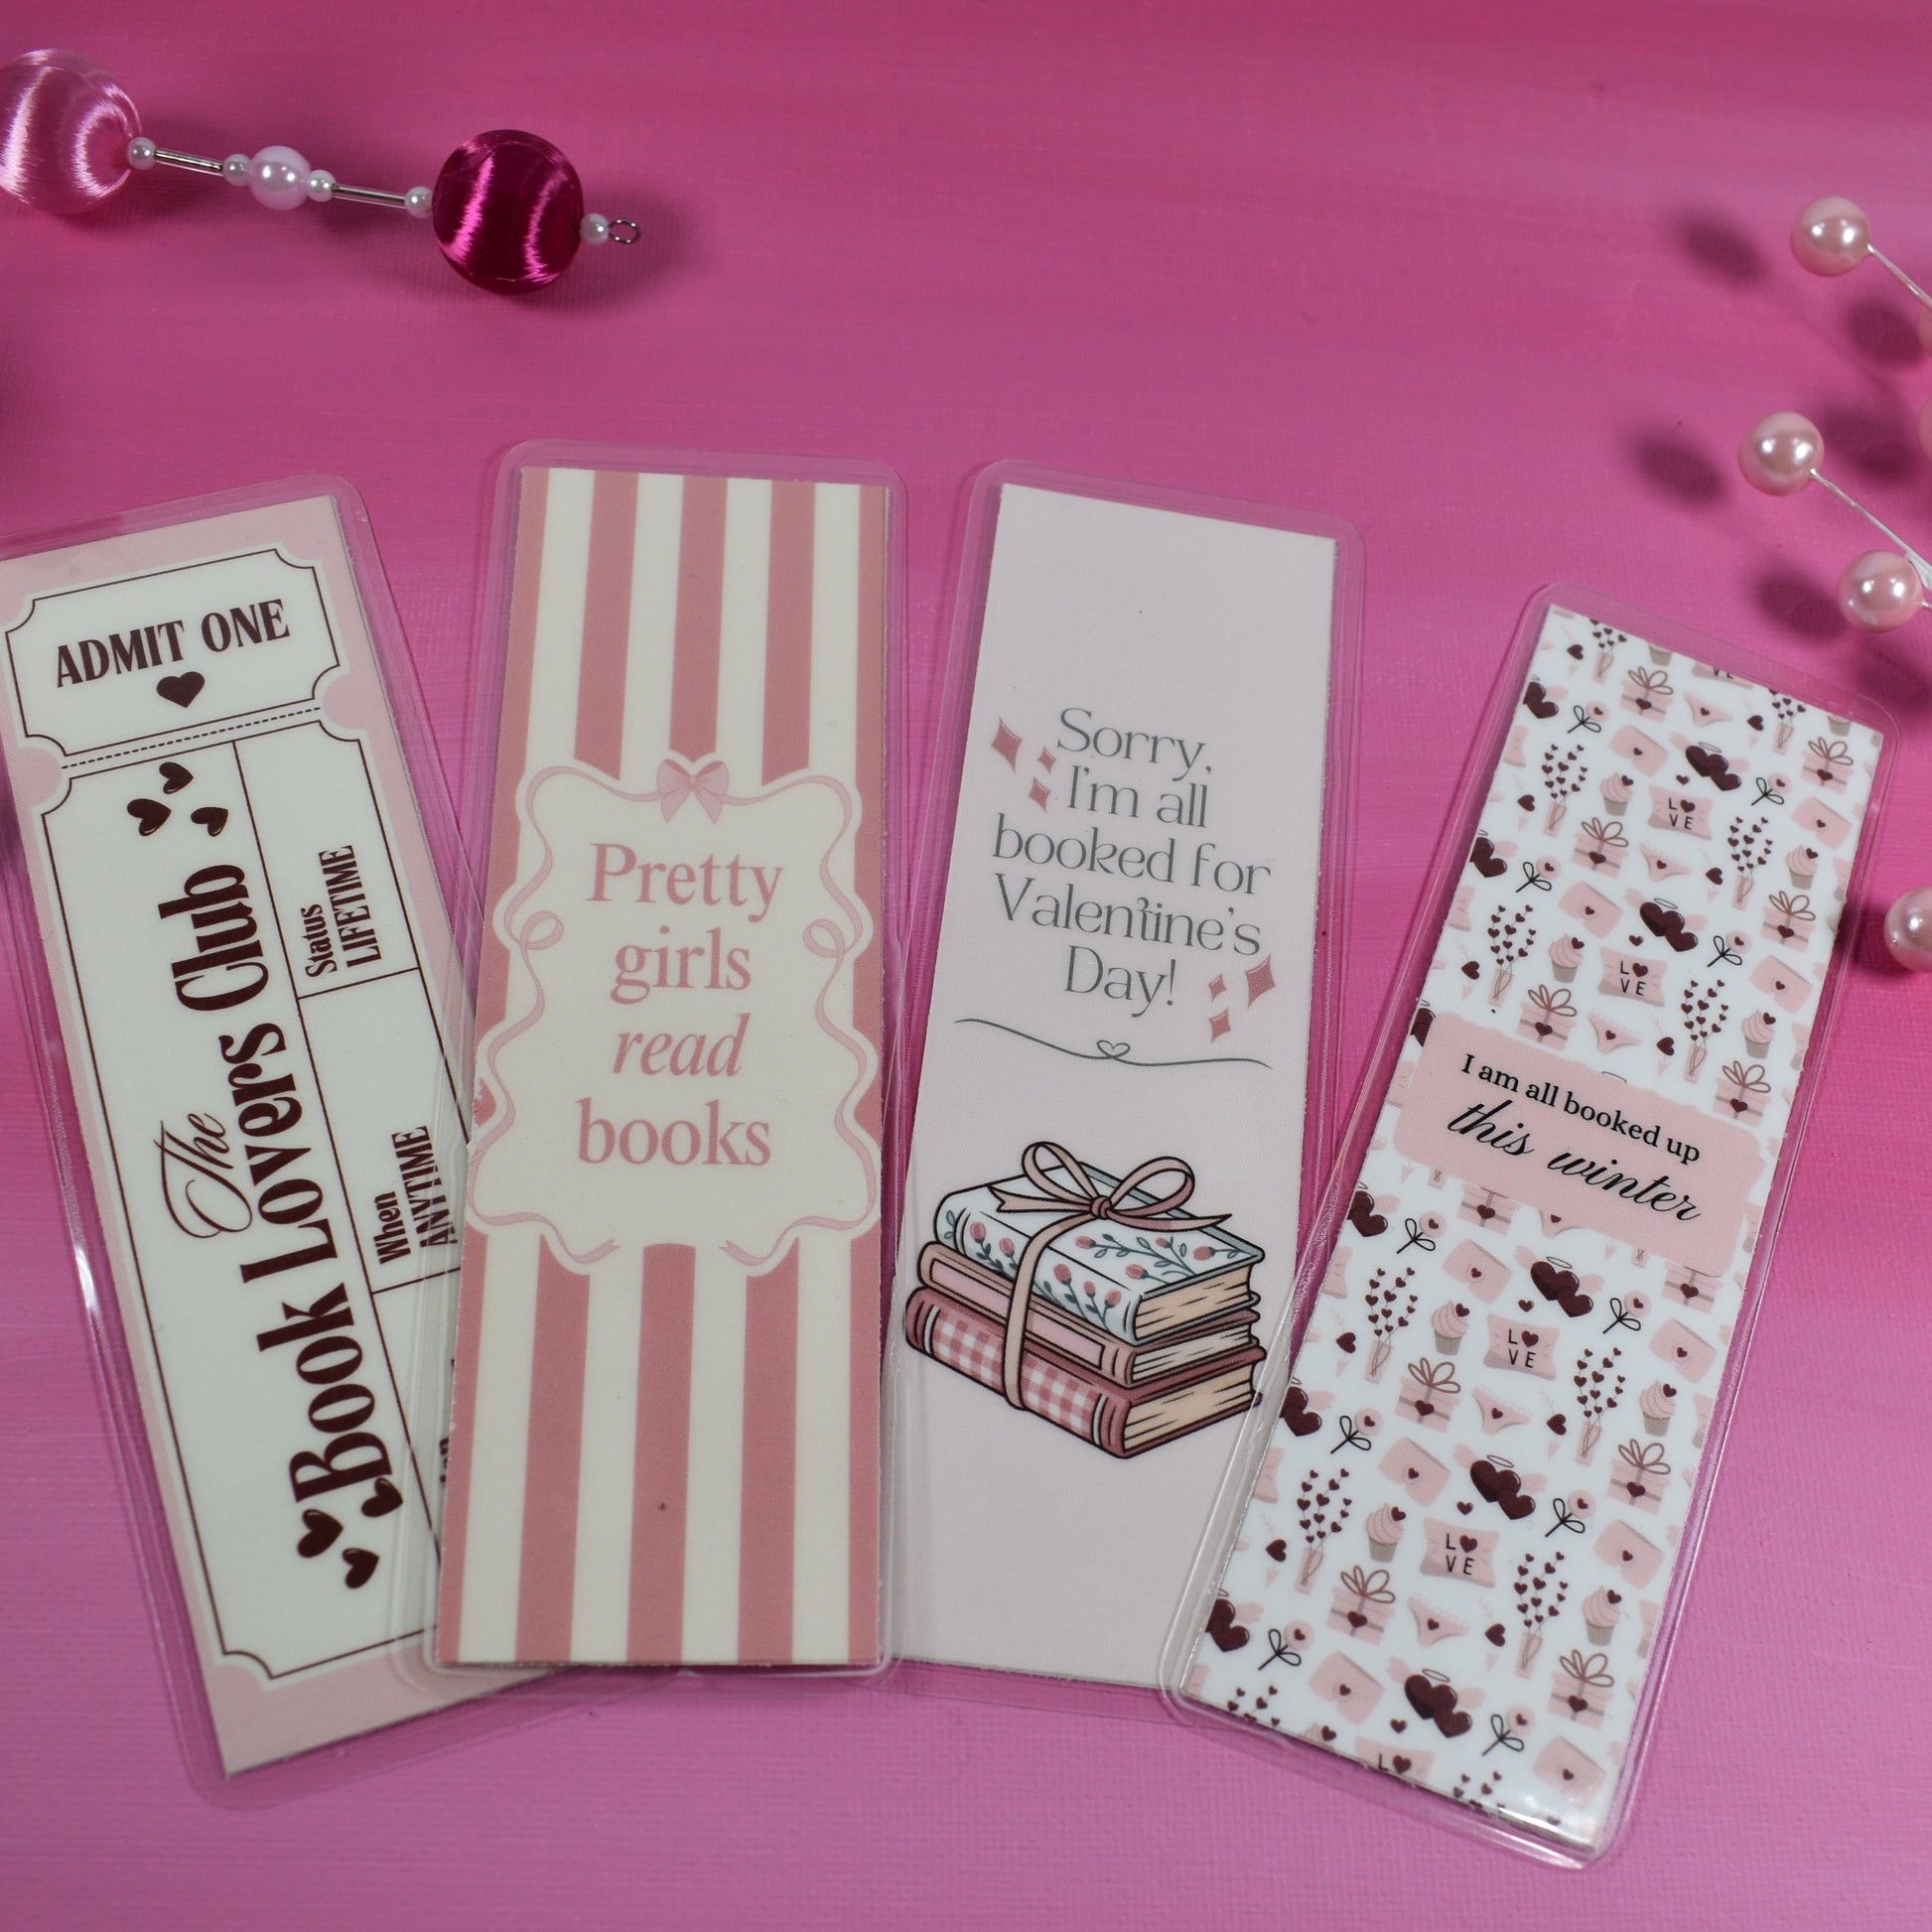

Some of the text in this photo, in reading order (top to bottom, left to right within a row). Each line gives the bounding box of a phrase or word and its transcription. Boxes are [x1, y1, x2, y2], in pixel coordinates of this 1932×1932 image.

[57, 599, 290, 688] ADMIT ONE
[1057, 707, 1212, 781] Sorry,
[1067, 764, 1208, 828] I'm all
[586, 843, 784, 922] Pretty
[993, 812, 1271, 895] booked for
[301, 903, 338, 978] Status
[319, 845, 382, 968] LIFETIME
[994, 872, 1262, 956] Valentine's
[610, 924, 752, 1005] girls
[1063, 944, 1176, 1018] Day!
[613, 1012, 751, 1077] read
[575, 1097, 771, 1167] books
[1461, 1053, 1701, 1165] I am all booked up
[153, 1112, 253, 1239] The
[158, 864, 393, 1503] Book Lovers Club
[391, 1126, 458, 1248] ANYTIME
[1447, 1099, 1701, 1221] this winter
[373, 1191, 411, 1265] When
